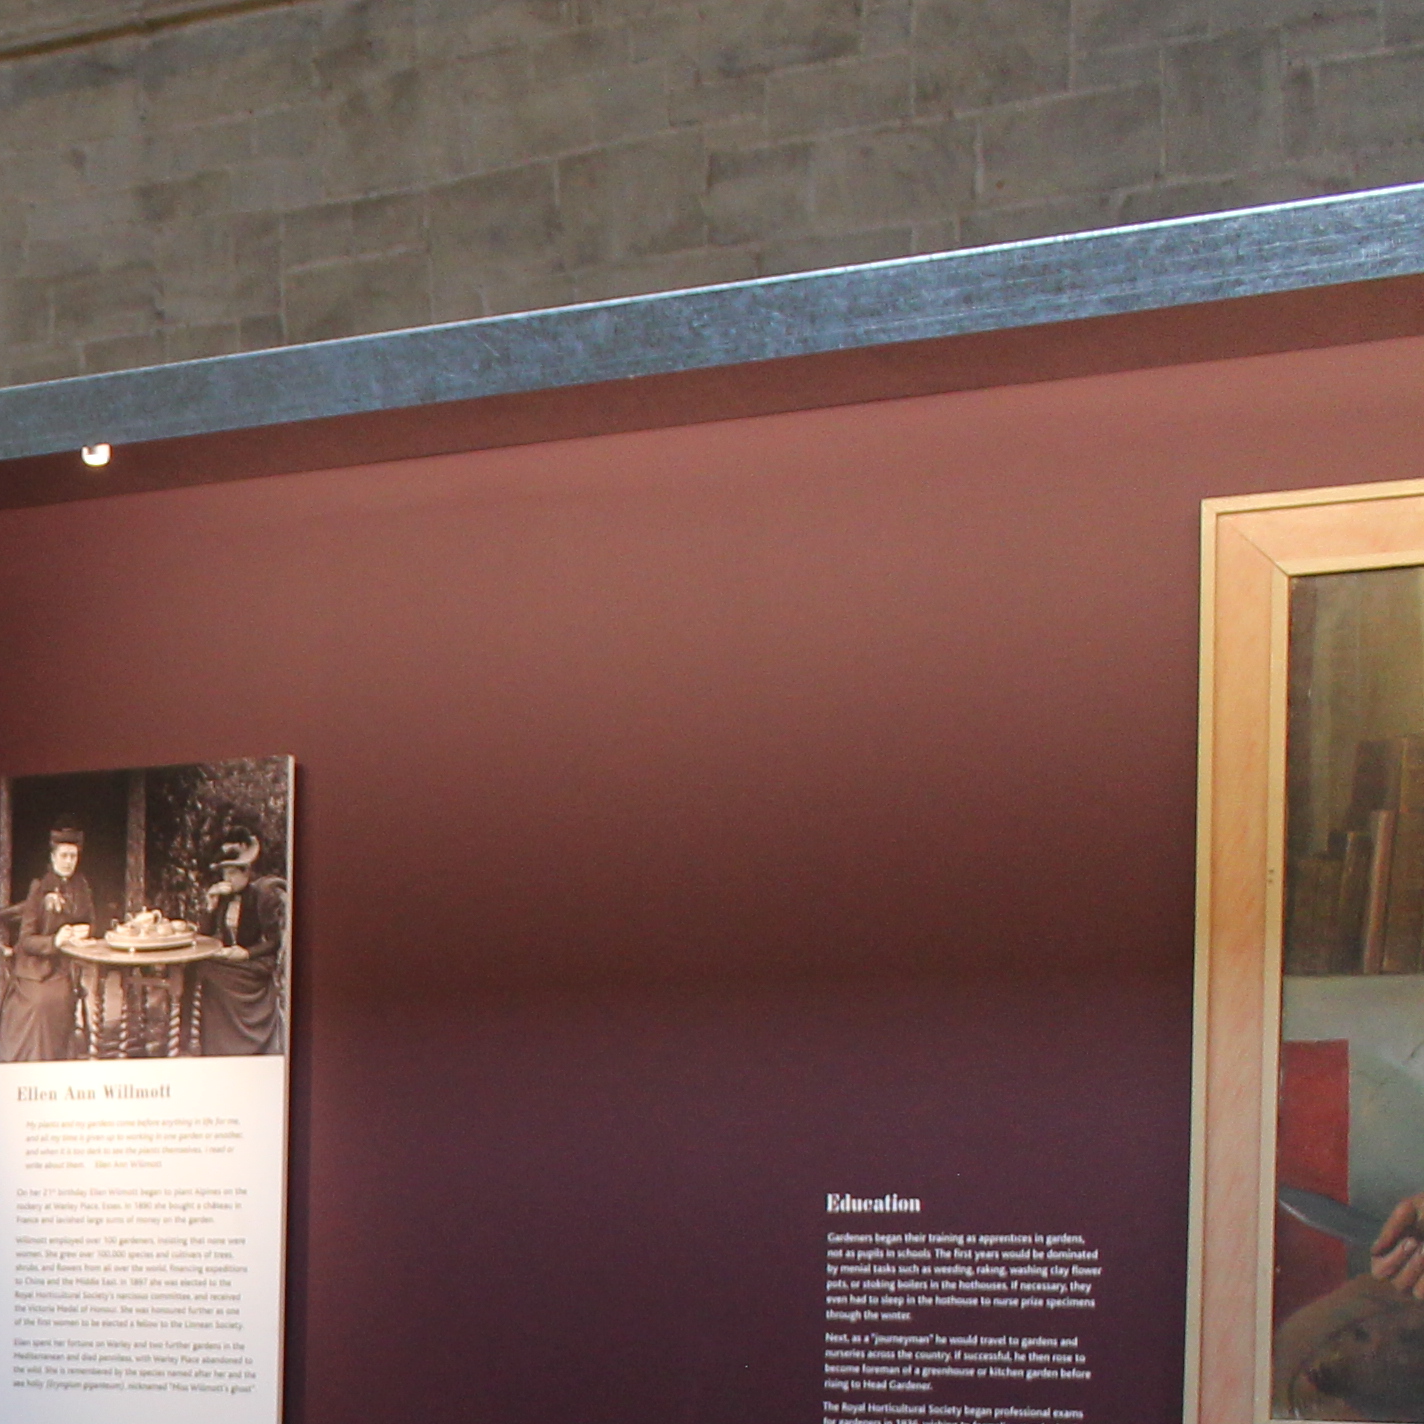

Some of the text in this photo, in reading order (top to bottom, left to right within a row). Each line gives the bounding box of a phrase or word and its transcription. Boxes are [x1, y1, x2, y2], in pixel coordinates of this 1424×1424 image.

[17, 1083, 171, 1101] Ellen Ann Willmott
[826, 1192, 921, 1212] Education
[827, 1232, 873, 1242] Gardeners
[875, 1232, 902, 1245] began
[904, 1233, 926, 1242] their
[928, 1233, 964, 1245] training
[979, 1233, 1032, 1246] apprentices
[827, 1249, 843, 1258] not
[857, 1248, 884, 1261] pupils
[935, 1248, 951, 1258] The
[954, 1248, 972, 1258] first
[974, 1251, 999, 1261] years
[1001, 1249, 1030, 1259] would
[1046, 1249, 1098, 1259] dominated
[840, 1263, 871, 1273] menial
[873, 1263, 896, 1273] tasks
[898, 1264, 919, 1273] such
[1010, 1264, 1048, 1277] washing
[1050, 1265, 1069, 1277] clay
[1072, 1265, 1101, 1275] flower
[863, 1279, 896, 1292] stoking
[897, 1280, 928, 1289] boilers
[941, 1280, 957, 1290] the
[1070, 1280, 1091, 1293] they
[826, 1309, 862, 1322] through
[864, 1309, 879, 1319] the
[949, 1334, 978, 1345] would
[980, 1335, 1006, 1345] travel
[1021, 1335, 1058, 1348] gardens
[1060, 1336, 1078, 1346] and
[824, 1363, 860, 1374] become
[862, 1364, 900, 1374] foreman
[922, 1365, 975, 1379] greenhouse
[989, 1366, 1024, 1377] kitchen
[1026, 1367, 1058, 1380] garden
[1060, 1368, 1091, 1378] before
[824, 1378, 849, 1391] rising
[863, 1379, 887, 1389] Head
[824, 1401, 1083, 1419] The Royal Horticultural Society began professional exams
